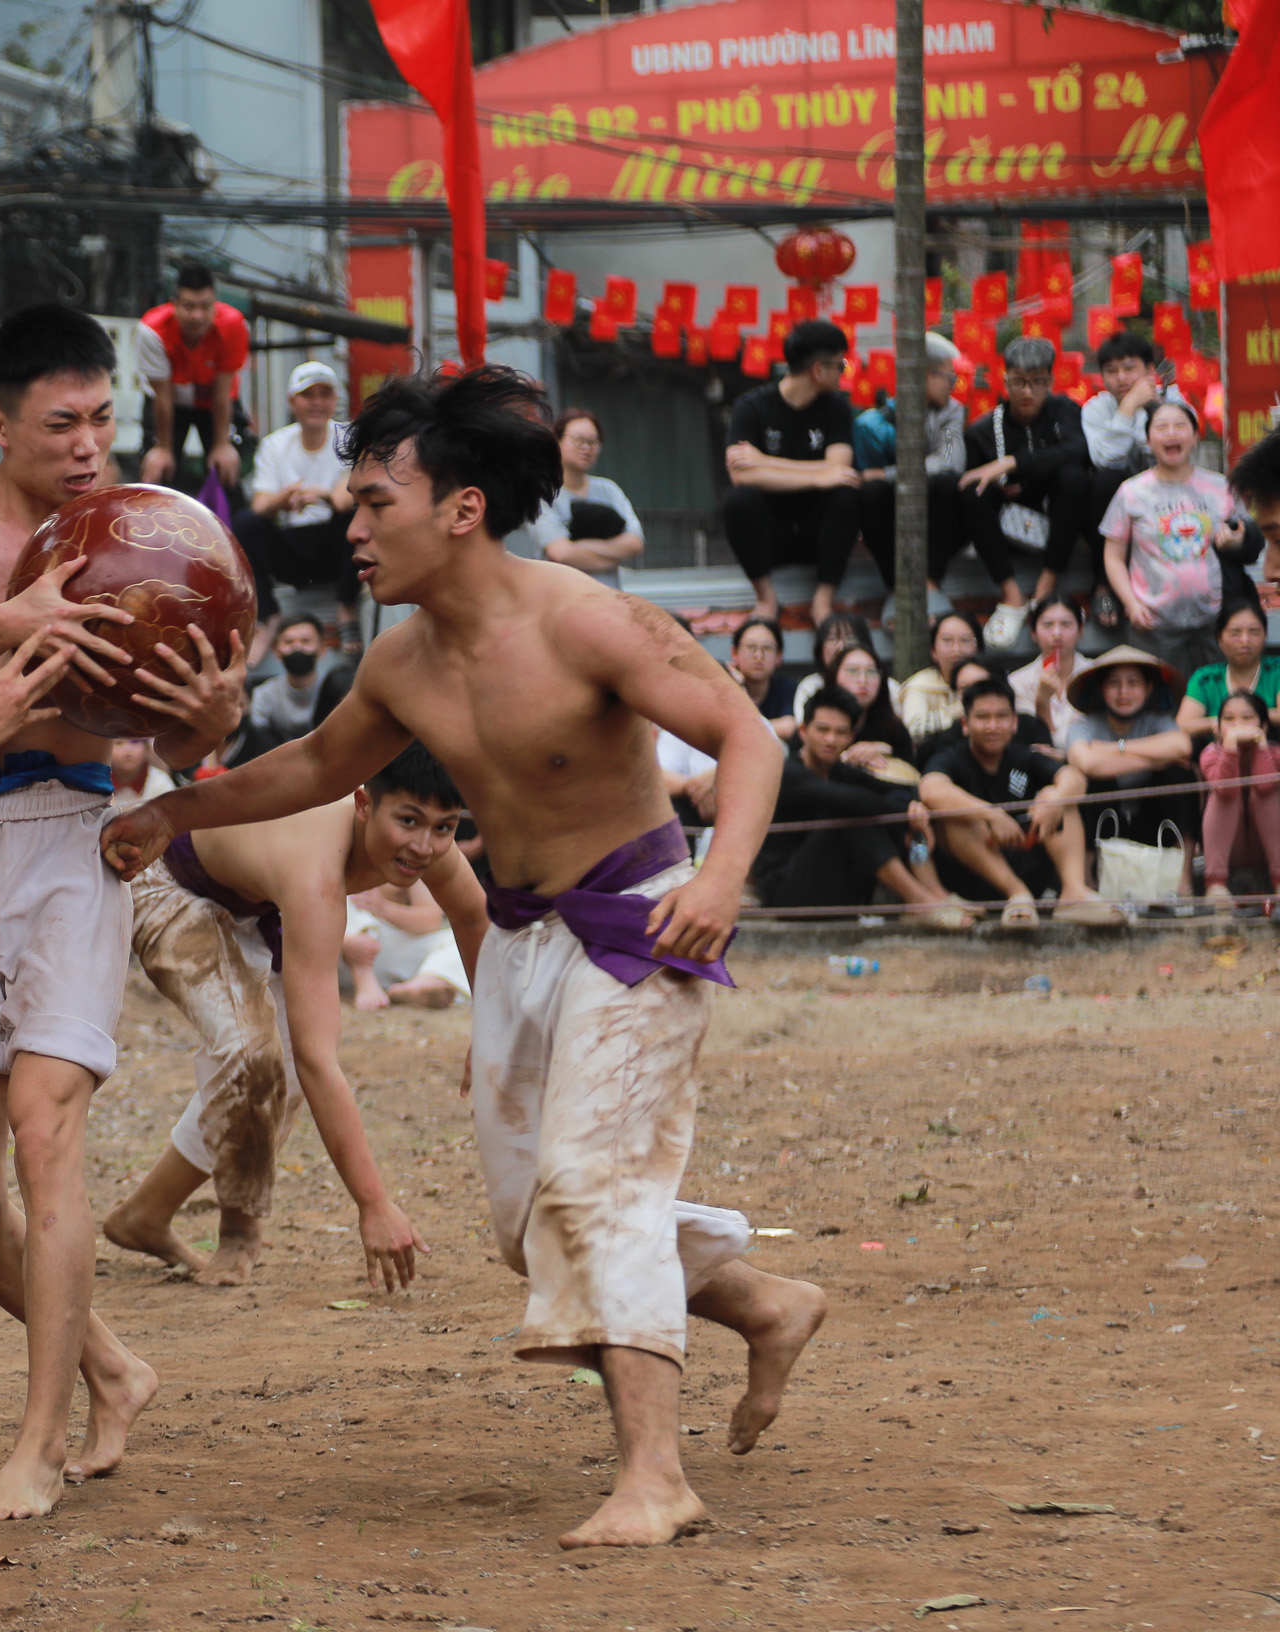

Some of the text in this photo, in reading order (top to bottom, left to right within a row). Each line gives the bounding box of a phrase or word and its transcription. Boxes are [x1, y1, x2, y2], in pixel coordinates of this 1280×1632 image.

[631, 20, 996, 75] UBND PHƯỜNG LĨN NAM
[1027, 61, 1083, 114] TỔ
[1093, 71, 1148, 111] 24
